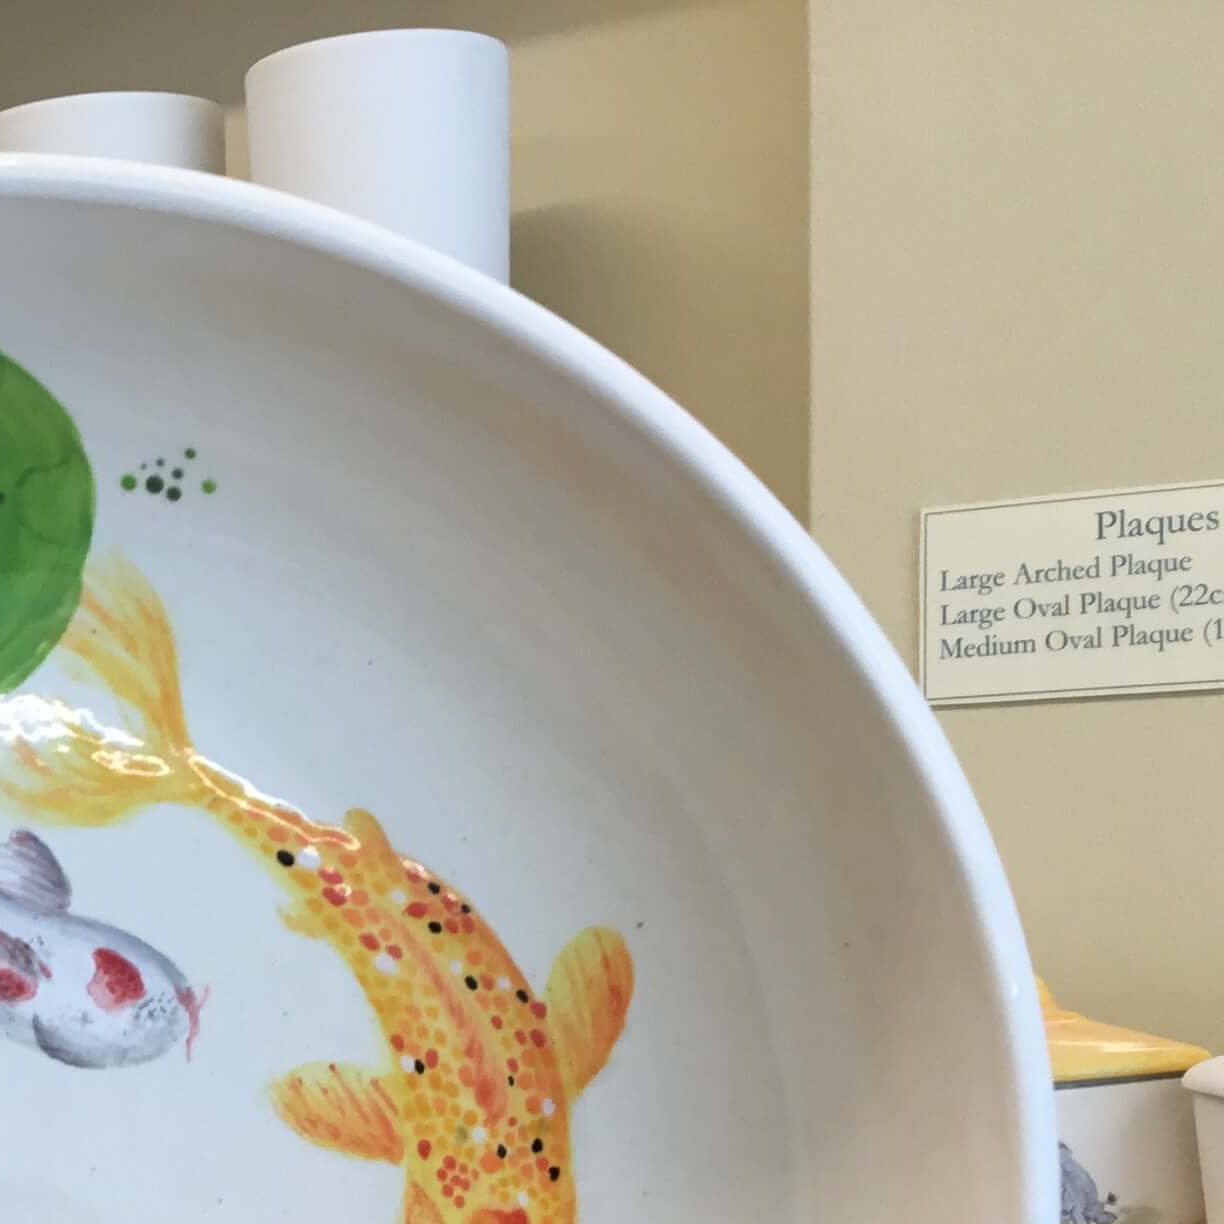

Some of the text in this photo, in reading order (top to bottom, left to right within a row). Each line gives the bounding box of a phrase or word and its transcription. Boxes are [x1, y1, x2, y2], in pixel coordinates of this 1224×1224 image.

[1095, 508, 1220, 545] Plaques
[939, 552, 1192, 596] Large Arched Plaque
[939, 604, 1006, 630] Large
[1014, 594, 1071, 620] Oval
[1080, 590, 1161, 620] Plaque
[939, 634, 1037, 660] Medium
[1045, 626, 1103, 652] Oval
[1112, 622, 1194, 652] Plaque
